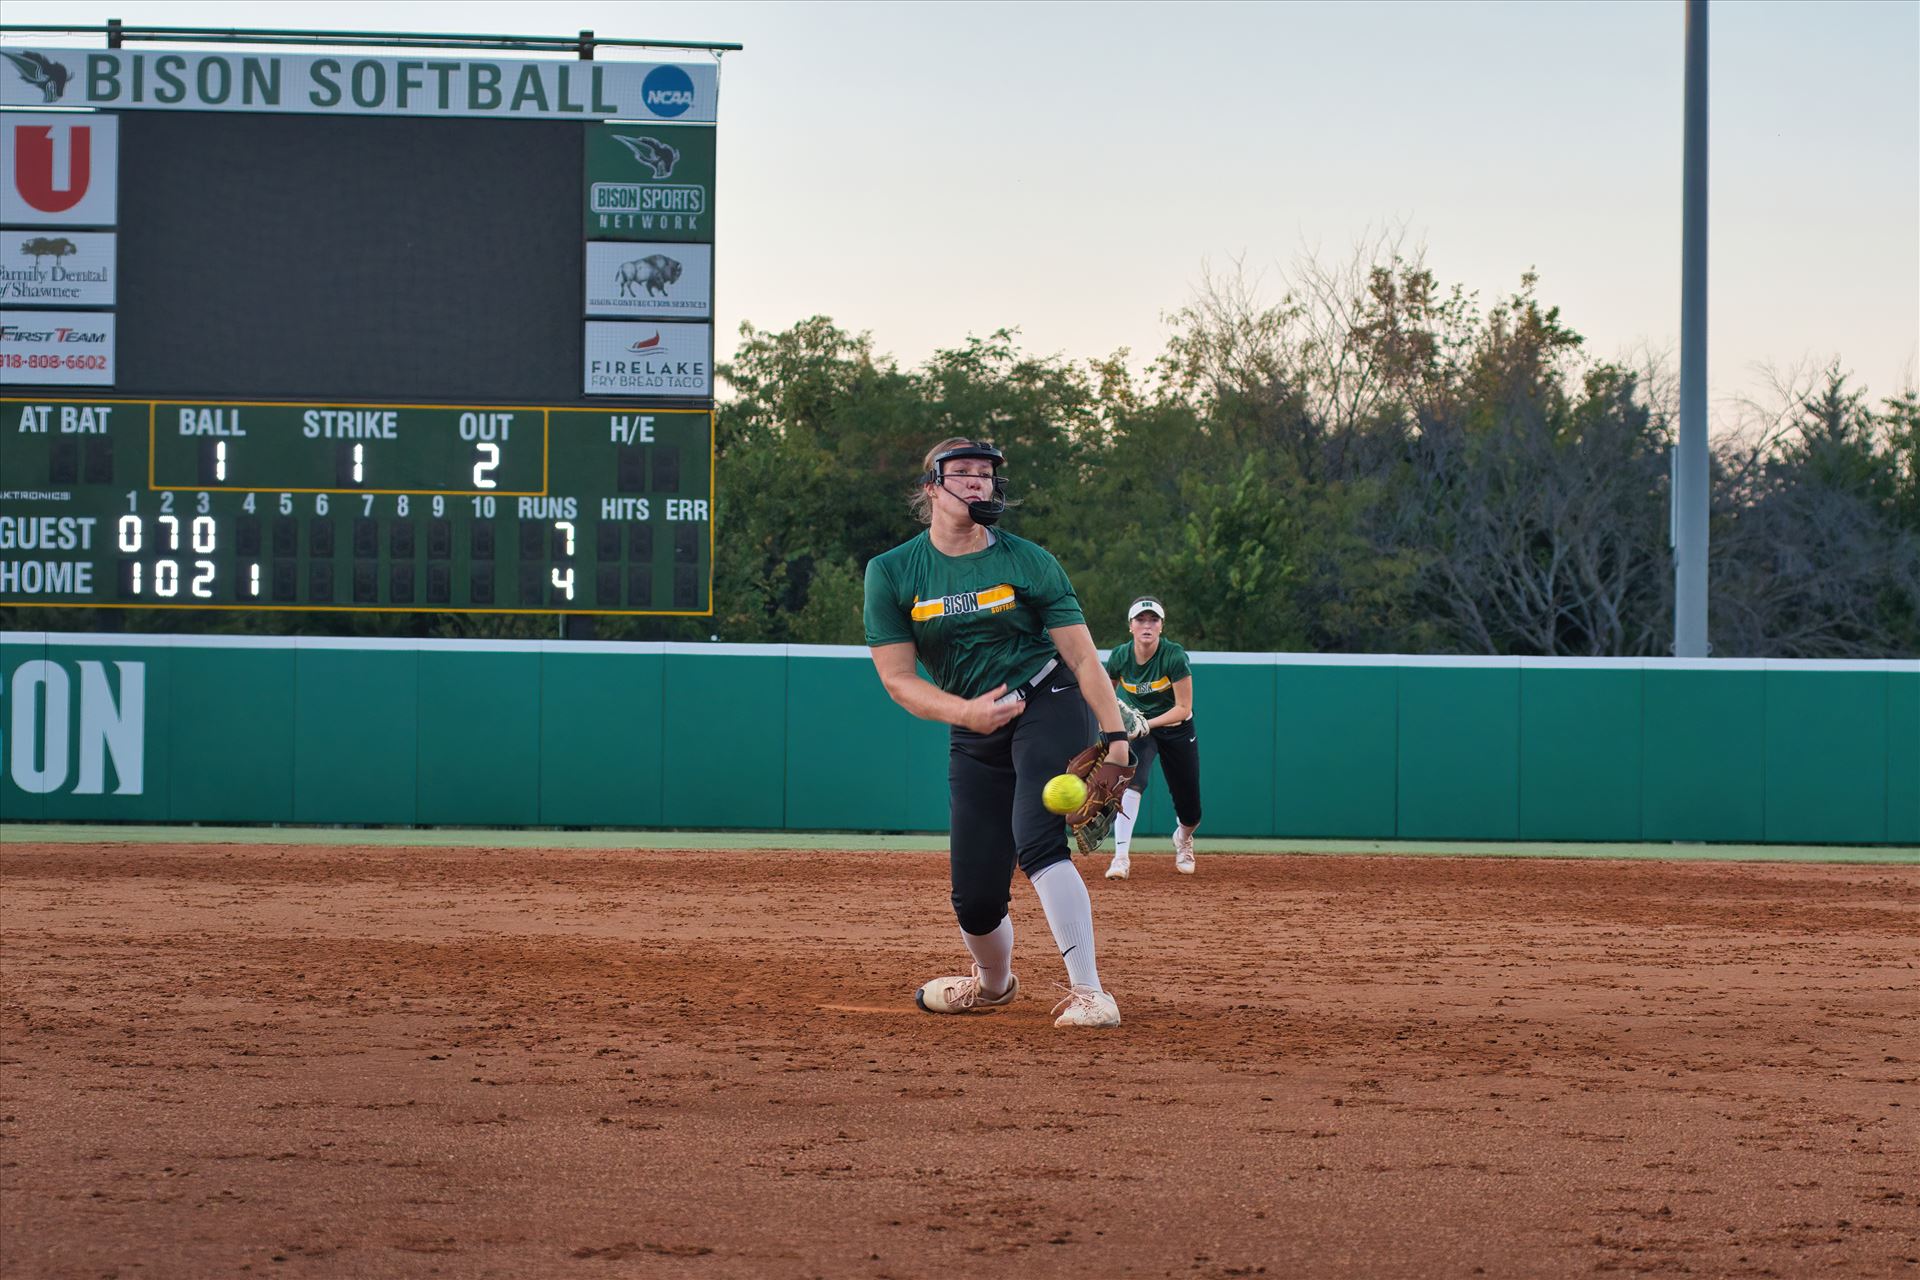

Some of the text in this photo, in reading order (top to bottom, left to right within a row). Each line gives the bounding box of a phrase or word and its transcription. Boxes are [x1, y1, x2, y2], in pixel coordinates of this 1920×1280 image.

[85, 53, 618, 114] BISON SOFTBALL
[647, 90, 693, 105] NCAA
[597, 187, 700, 210] BISON SPORTS
[599, 214, 698, 230] NETWORK
[51, 265, 108, 282] Dental
[11, 281, 80, 298] Shawnee
[55, 328, 107, 343] TEAM
[591, 361, 704, 375] FIRELAKE
[591, 375, 704, 389] FRY BREAD TACO
[18, 406, 113, 435] AT BAT
[178, 408, 247, 437] BALL
[303, 410, 398, 439] STRIKE
[459, 412, 514, 441] OUT
[610, 416, 655, 445] H/E
[216, 441, 226, 482] 1
[353, 443, 363, 483] 1
[473, 443, 500, 489] 2
[126, 490, 708, 521] 1 2 3 4 5 6 7 8 9 10 RUNS HITS ERR
[0, 516, 96, 550] GUEST
[554, 521, 575, 556] 7
[0, 560, 93, 594] HOME
[251, 563, 260, 597] 1
[551, 568, 575, 600] 4
[943, 592, 980, 615] BISON
[0, 659, 145, 795] ON
